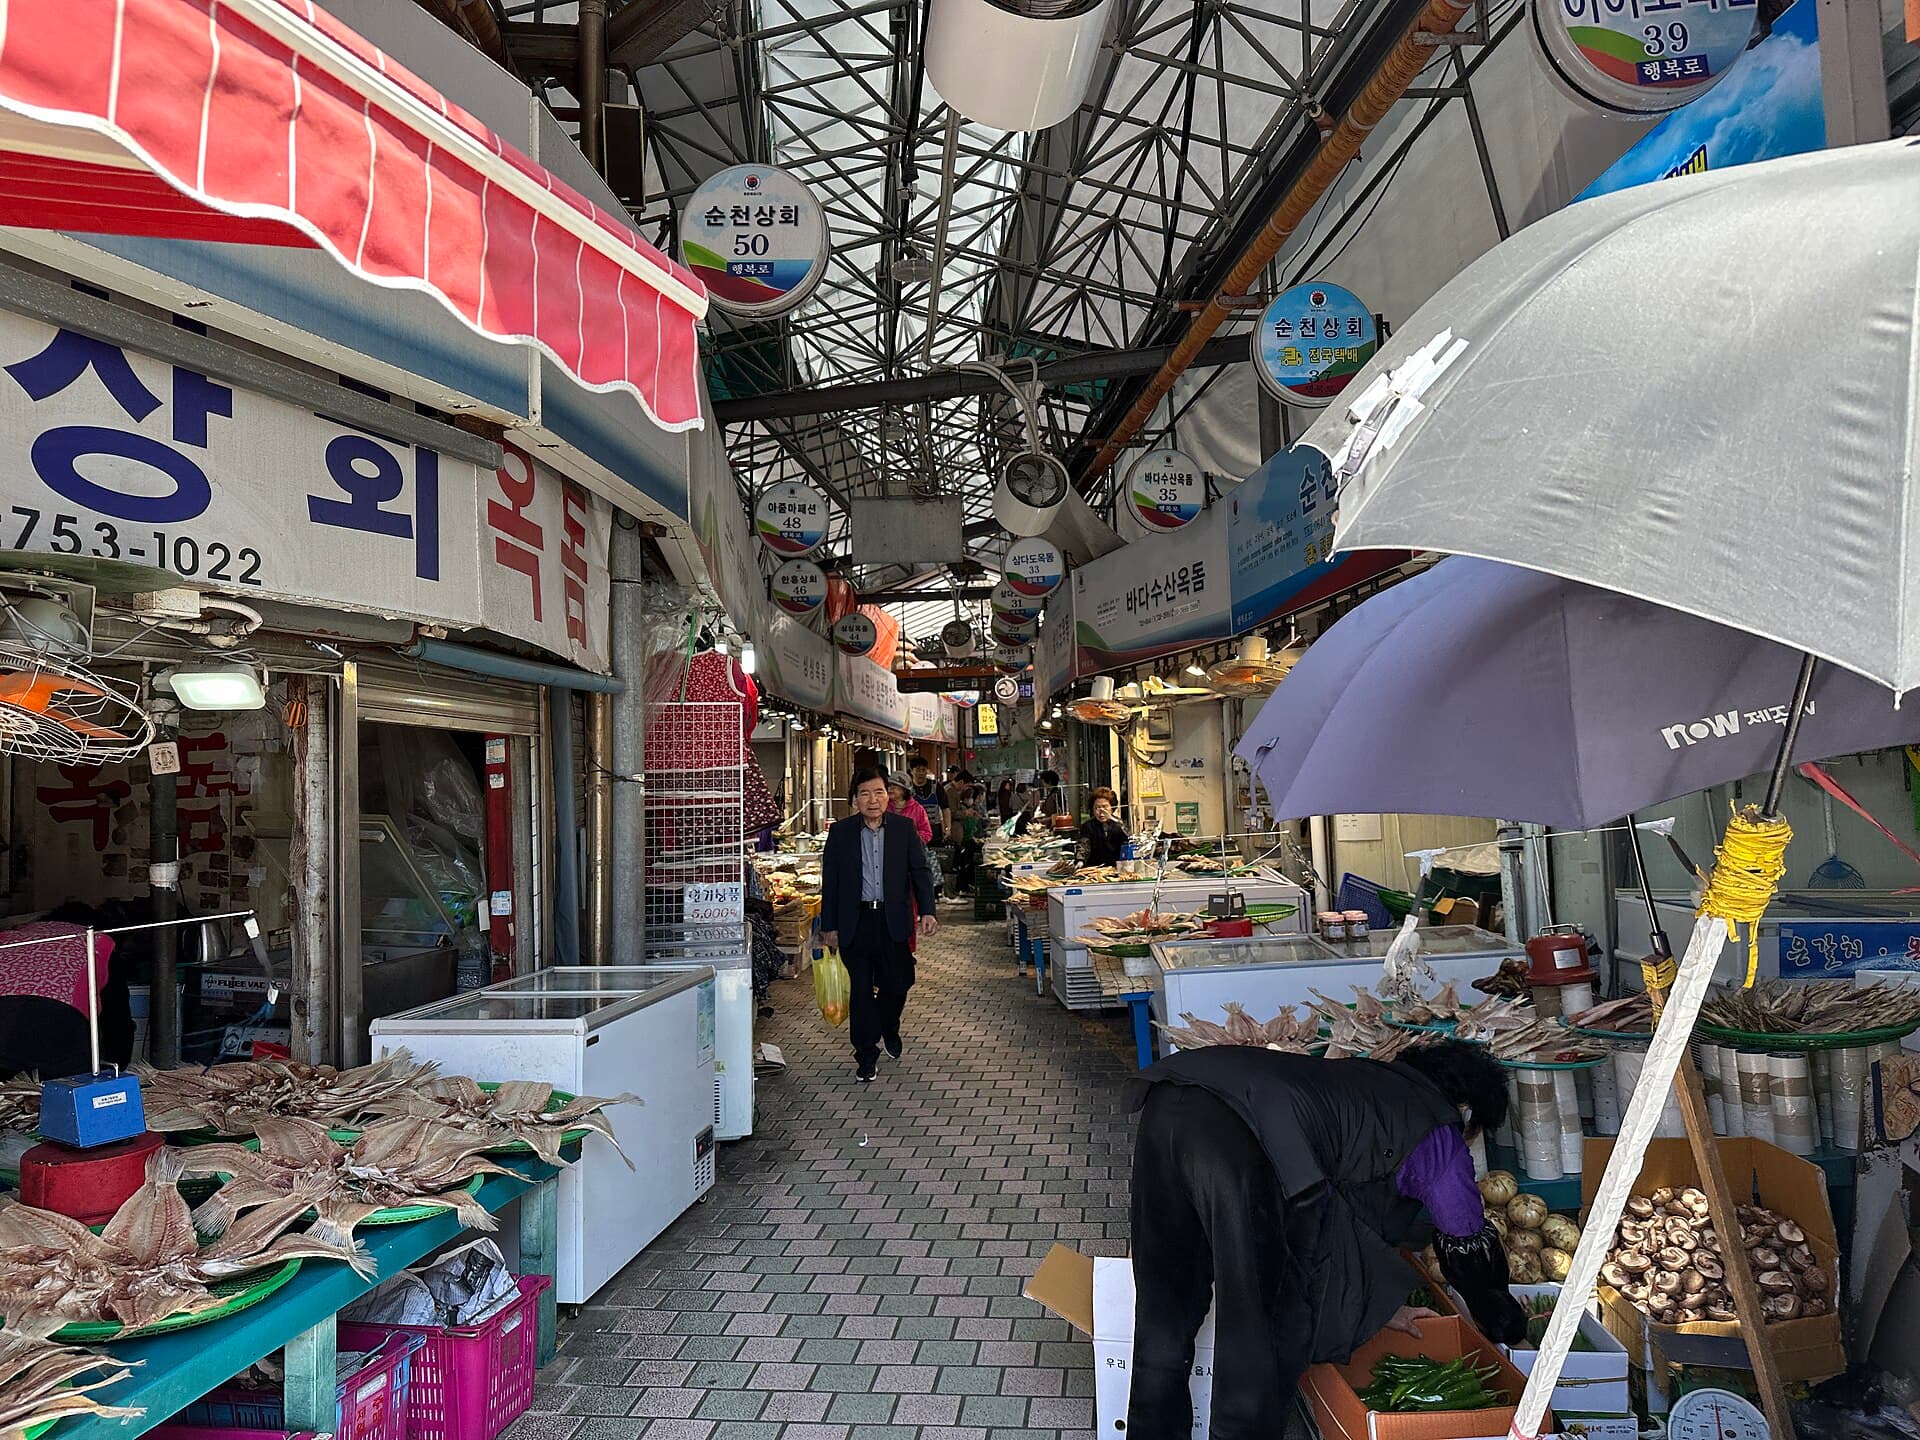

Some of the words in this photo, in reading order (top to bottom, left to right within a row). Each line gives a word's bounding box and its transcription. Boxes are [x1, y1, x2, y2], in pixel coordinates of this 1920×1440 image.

[1644, 24, 1689, 55] 39
[1643, 58, 1702, 80] 행복로
[704, 204, 799, 227] 순천상회
[733, 233, 769, 256] 50
[732, 263, 770, 275] 행복로
[1274, 317, 1364, 338] 순천상회
[1308, 347, 1359, 363] 전국택배
[1309, 369, 1332, 382] 37
[4, 312, 440, 582] 상회
[1144, 472, 1193, 486] 바다수산옥돔
[1159, 488, 1177, 501] 35
[768, 501, 816, 515] 아줌마패션
[782, 517, 801, 529] 48
[1012, 552, 1054, 566] 삼다도옥돔
[1029, 566, 1040, 575] 33
[792, 585, 808, 595] 46
[1126, 560, 1206, 615] 바다수산옥돔
[1011, 600, 1023, 608] 31
[1661, 709, 1740, 750] now
[1787, 934, 1863, 970] 은갈치
[1105, 1357, 1127, 1370] 우리
